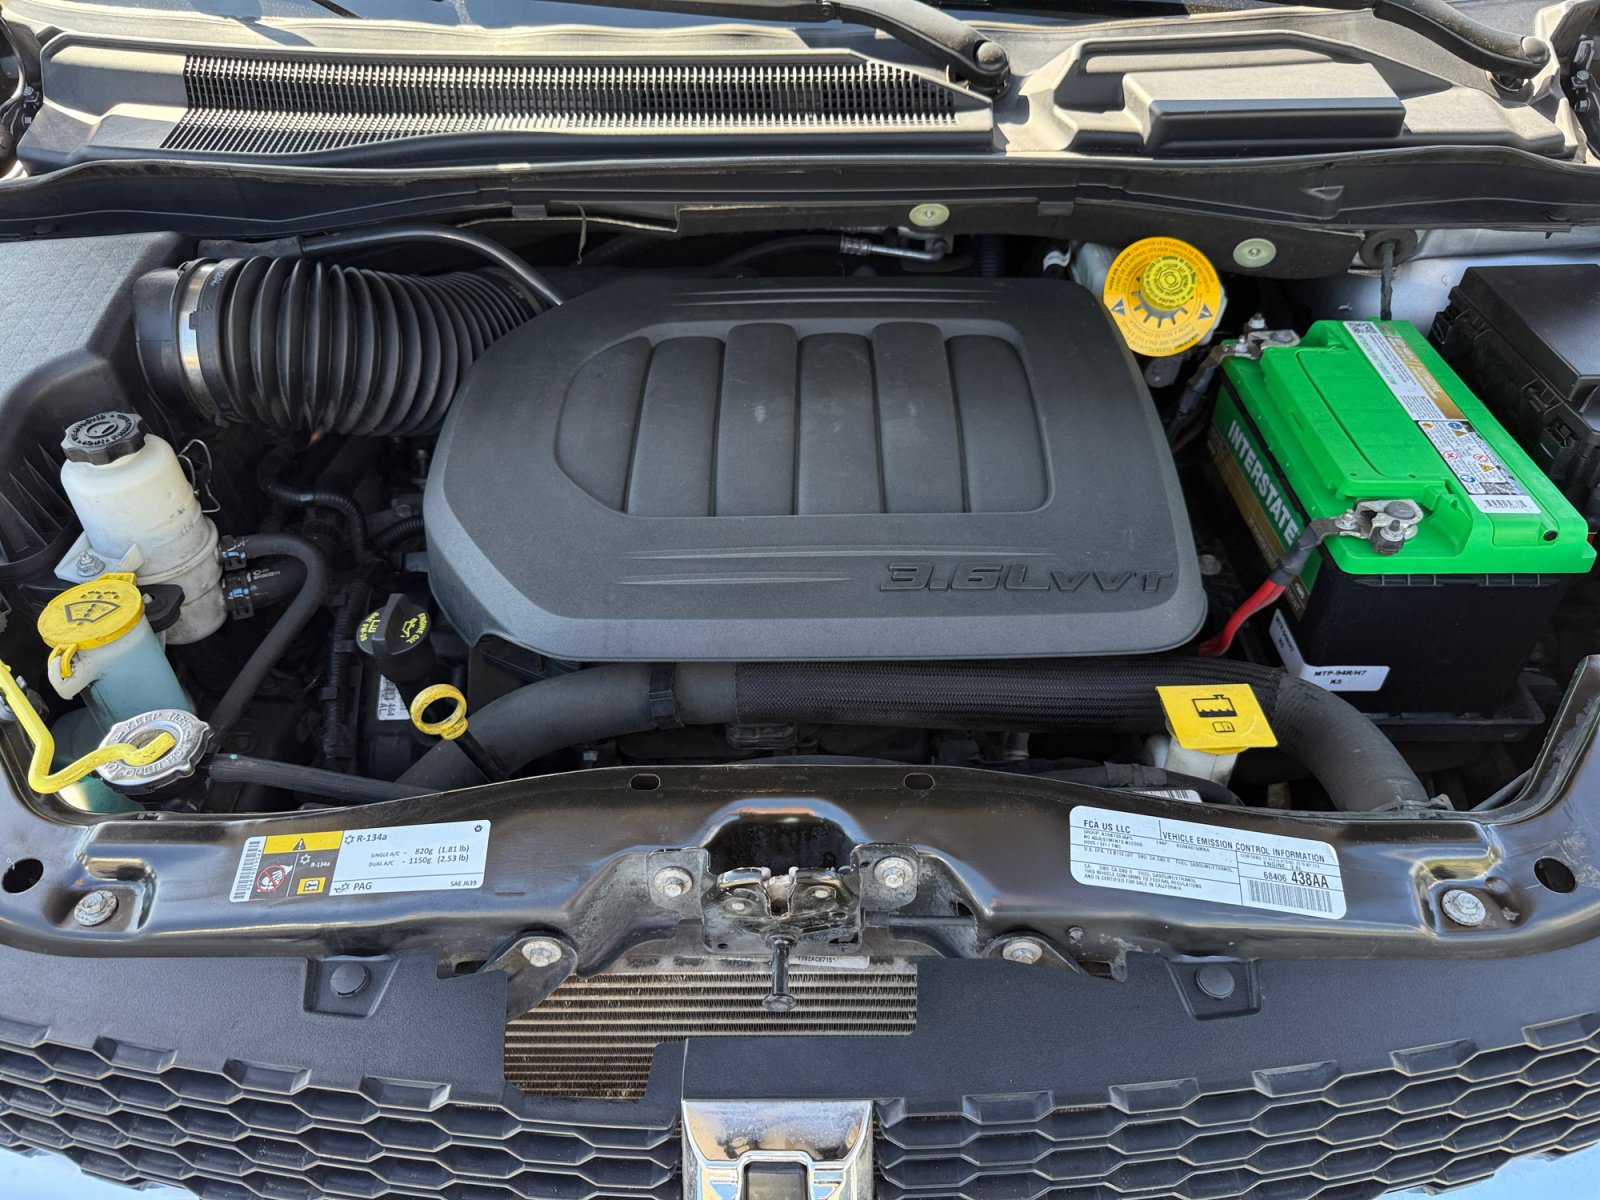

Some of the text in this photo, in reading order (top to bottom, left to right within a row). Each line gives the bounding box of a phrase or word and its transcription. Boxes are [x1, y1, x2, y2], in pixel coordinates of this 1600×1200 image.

[1228, 420, 1299, 546] INTERSTATE
[406, 634, 420, 644] OIL
[1084, 819, 1130, 833] FCA US LLC
[356, 833, 388, 843] R-134a
[415, 847, 434, 856] 820g
[438, 845, 457, 855] (1.81
[459, 845, 470, 853] lb)
[1162, 831, 1194, 842] VEHICLE
[1196, 836, 1232, 848] EMISSION
[1235, 842, 1269, 854] CONTROL
[1272, 848, 1324, 862] INFORMATION
[409, 857, 432, 865] 1150g
[437, 855, 457, 864] (2.53
[459, 854, 469, 863] lb)
[1263, 871, 1328, 888] 68406 438AA
[353, 881, 373, 891] PAG
